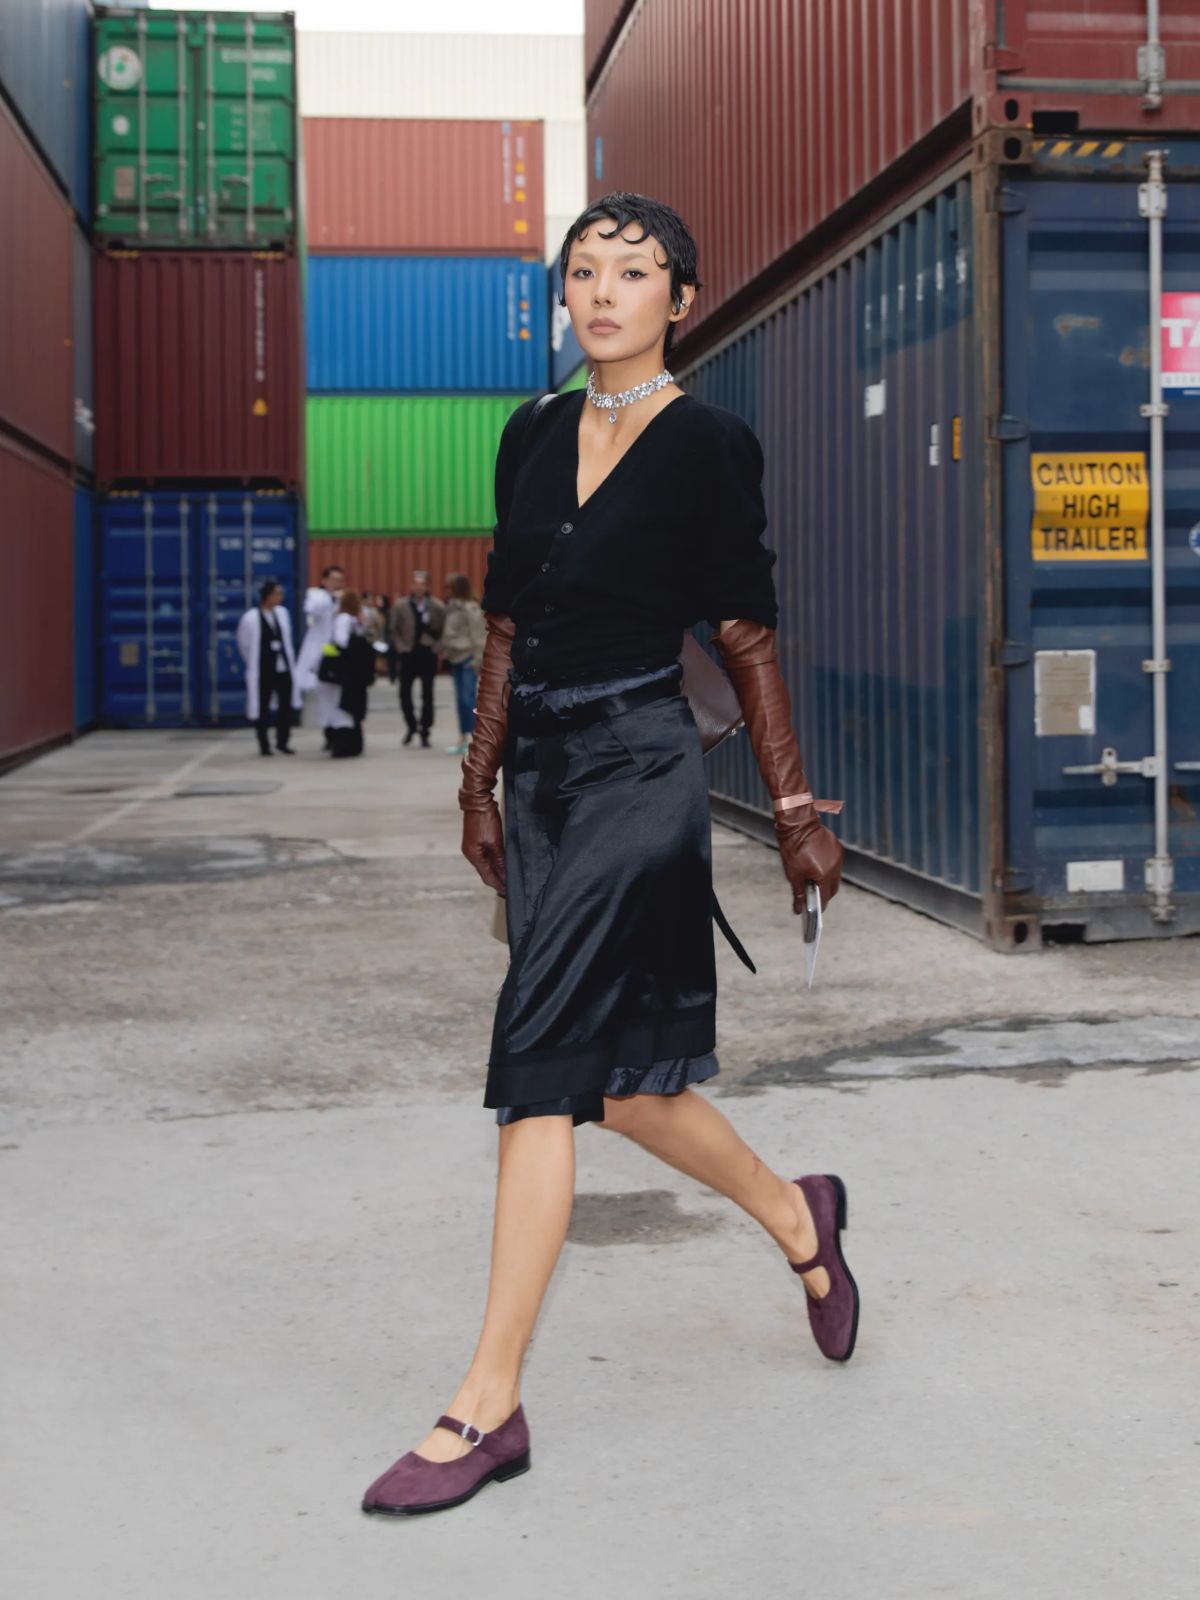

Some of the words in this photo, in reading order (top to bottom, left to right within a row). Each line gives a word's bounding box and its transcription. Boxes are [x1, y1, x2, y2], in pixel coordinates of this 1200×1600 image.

[1037, 463, 1141, 485] CAUTION
[1062, 495, 1120, 518] HIGH
[1040, 528, 1138, 551] TRAILER
